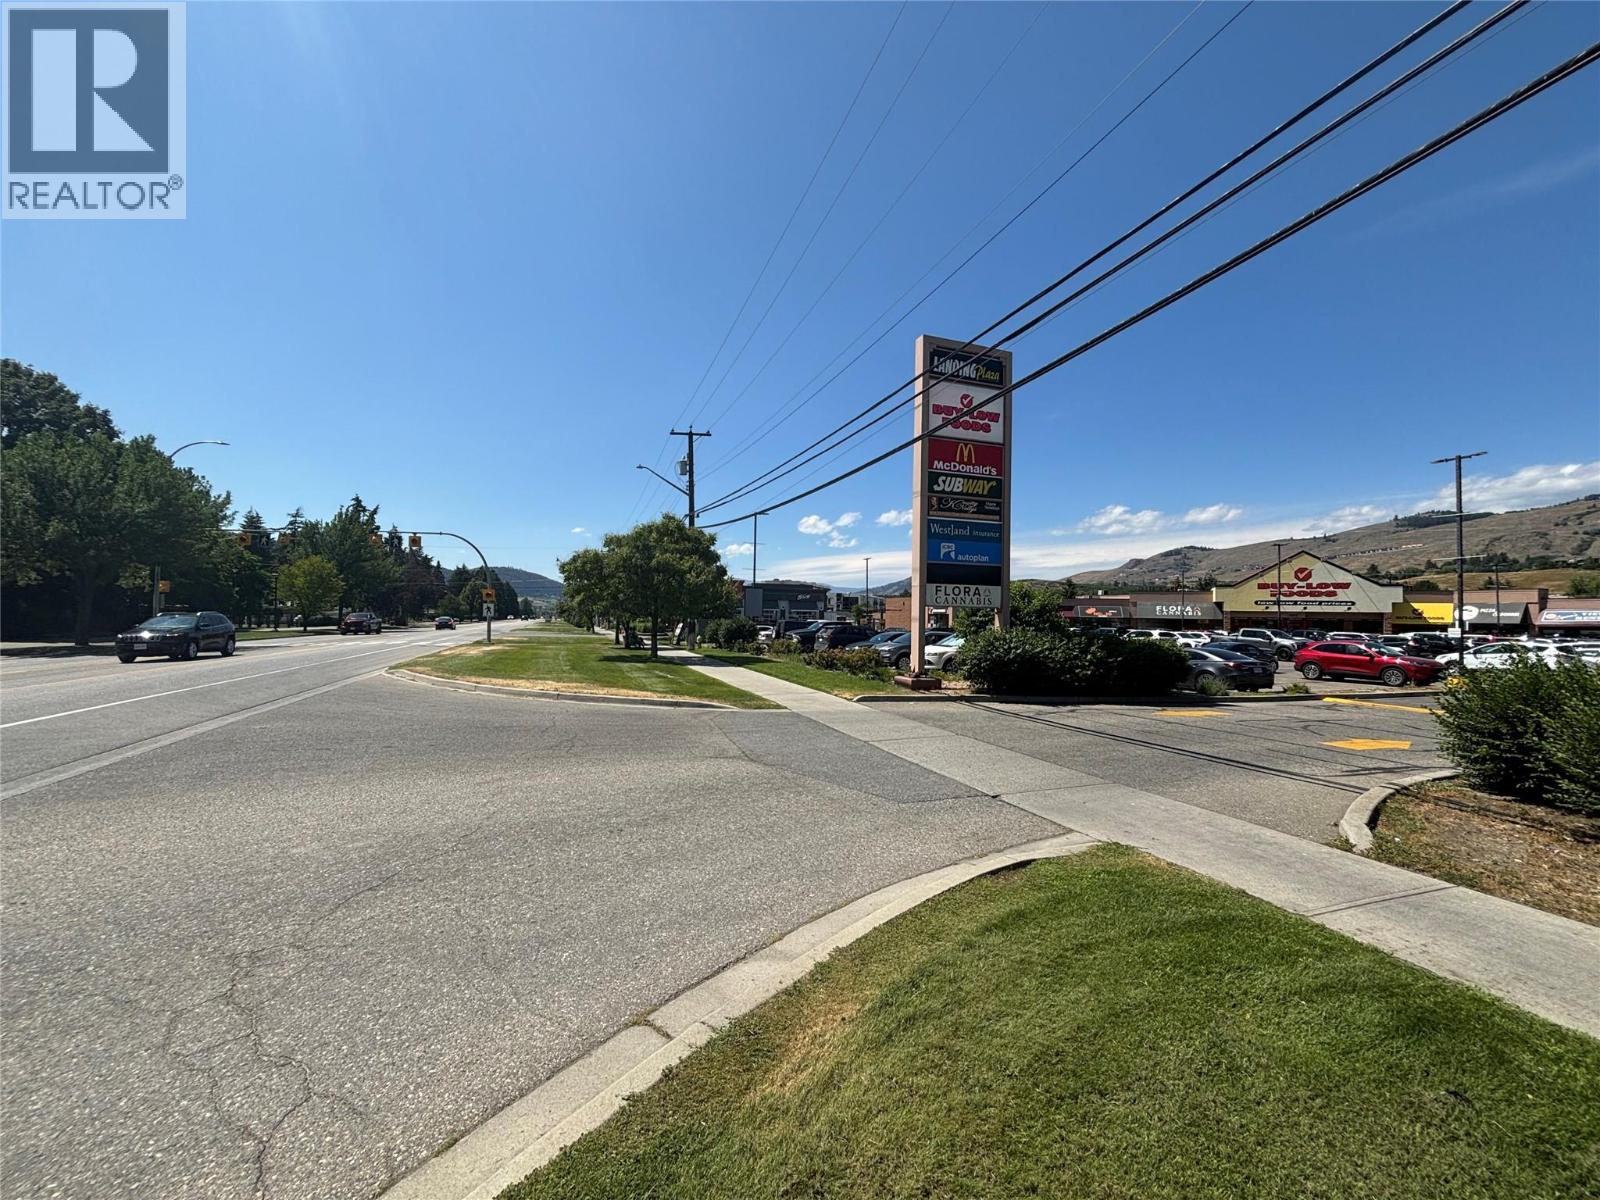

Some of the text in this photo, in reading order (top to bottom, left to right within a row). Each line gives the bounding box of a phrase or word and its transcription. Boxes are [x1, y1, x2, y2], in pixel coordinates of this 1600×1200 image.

[975, 365, 1000, 380] Plaza
[932, 404, 1000, 423] BUYLOW
[933, 460, 997, 476] McDonald's
[933, 476, 997, 495] SUBWAY
[930, 523, 970, 536] Westland
[957, 553, 989, 562] autoplan
[935, 586, 981, 597] FLORA
[1257, 582, 1352, 590] BUY-LOW
[935, 596, 992, 605] CANNABIS
